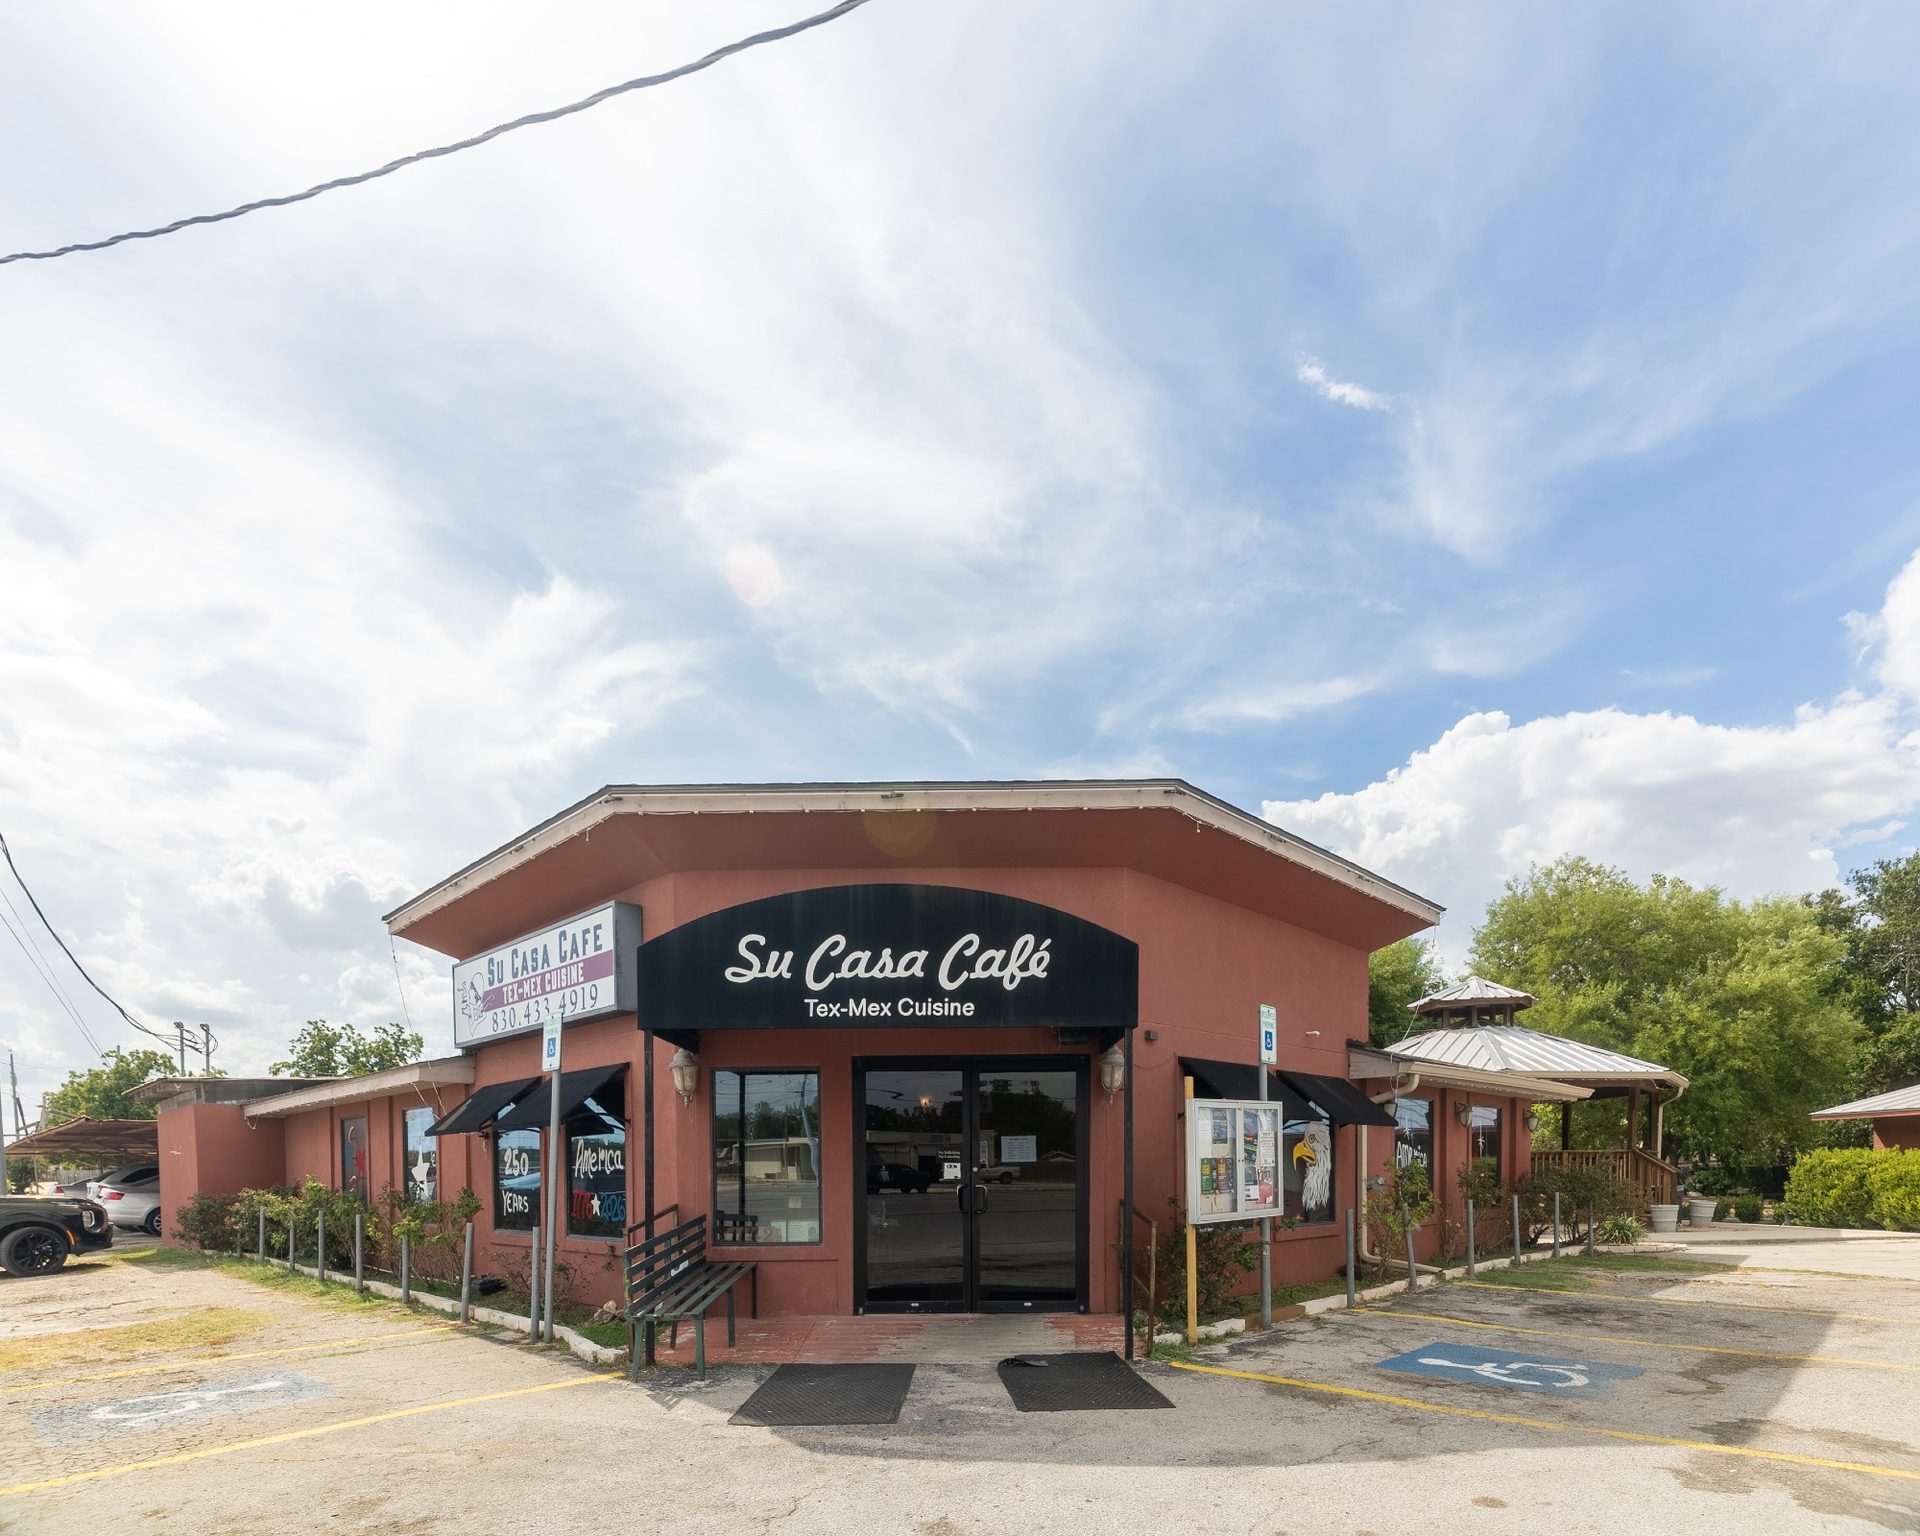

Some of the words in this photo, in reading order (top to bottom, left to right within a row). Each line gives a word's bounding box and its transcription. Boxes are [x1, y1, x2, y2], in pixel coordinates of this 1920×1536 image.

[724, 933, 794, 984] Su
[805, 934, 929, 991] Casa
[938, 933, 1053, 991] Café
[502, 975, 542, 1005] TEX-MEX
[544, 962, 584, 992] CUISINE
[804, 998, 892, 1017] Tex-Mex
[897, 998, 975, 1017] Cuisine
[504, 1148, 529, 1177] 250
[575, 1138, 624, 1179] America
[502, 1190, 529, 1216] YEARS
